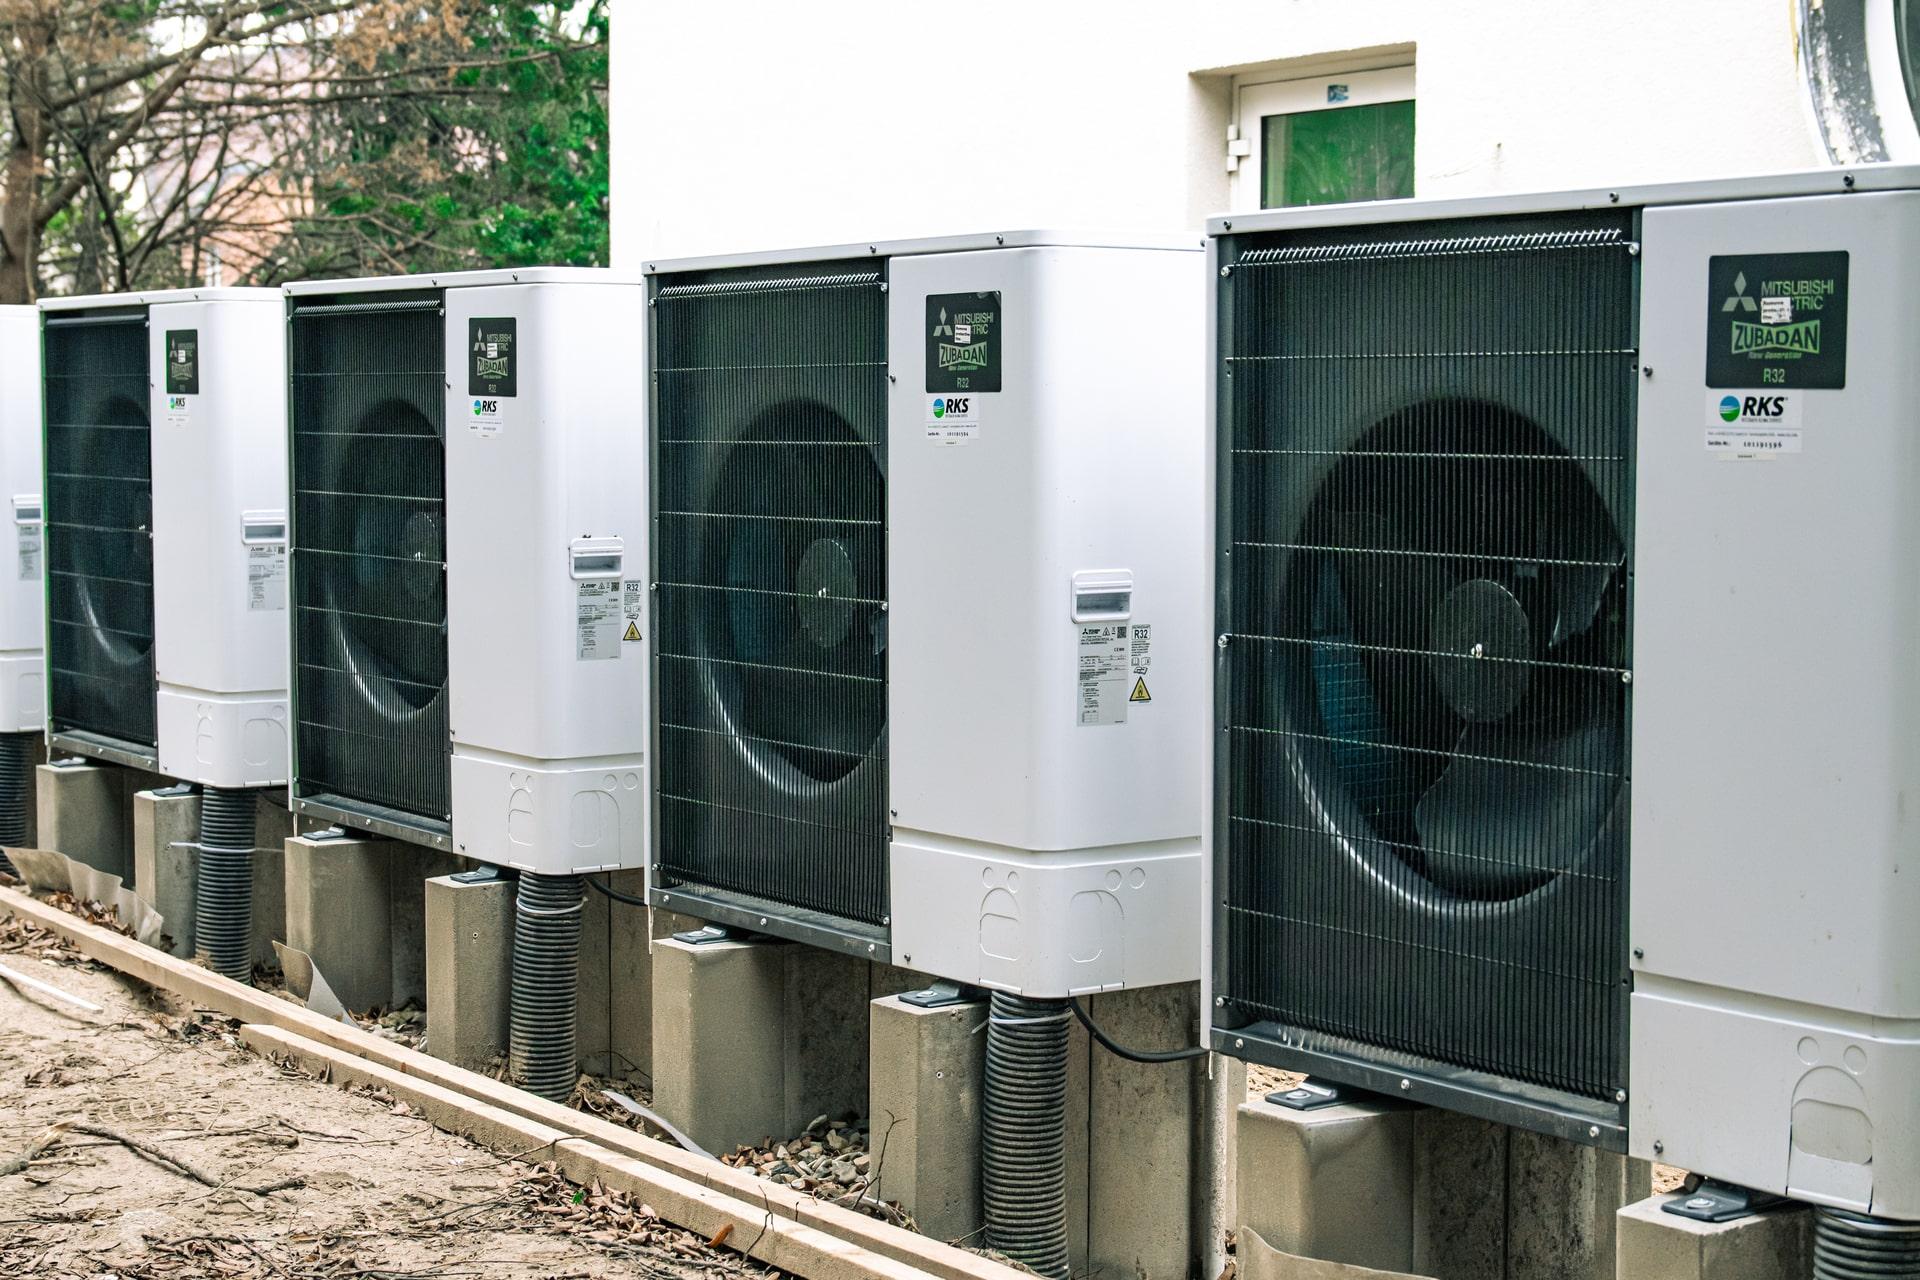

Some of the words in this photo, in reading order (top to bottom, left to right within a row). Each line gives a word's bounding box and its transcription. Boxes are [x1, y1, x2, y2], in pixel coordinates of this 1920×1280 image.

[1760, 279, 1834, 297] MITSUBISHI
[954, 312, 994, 325] MITSUBISHI
[1733, 323, 1820, 353] ZUBADAN
[940, 344, 986, 366] ZUBADAN
[478, 357, 507, 375] ZUBADAN
[956, 377, 970, 389] R32
[1763, 367, 1785, 383] R32
[482, 400, 497, 412] RKS
[945, 398, 969, 414] RKS
[1742, 396, 1785, 416] RKS
[626, 583, 639, 592] R32
[1134, 629, 1148, 639] R32
